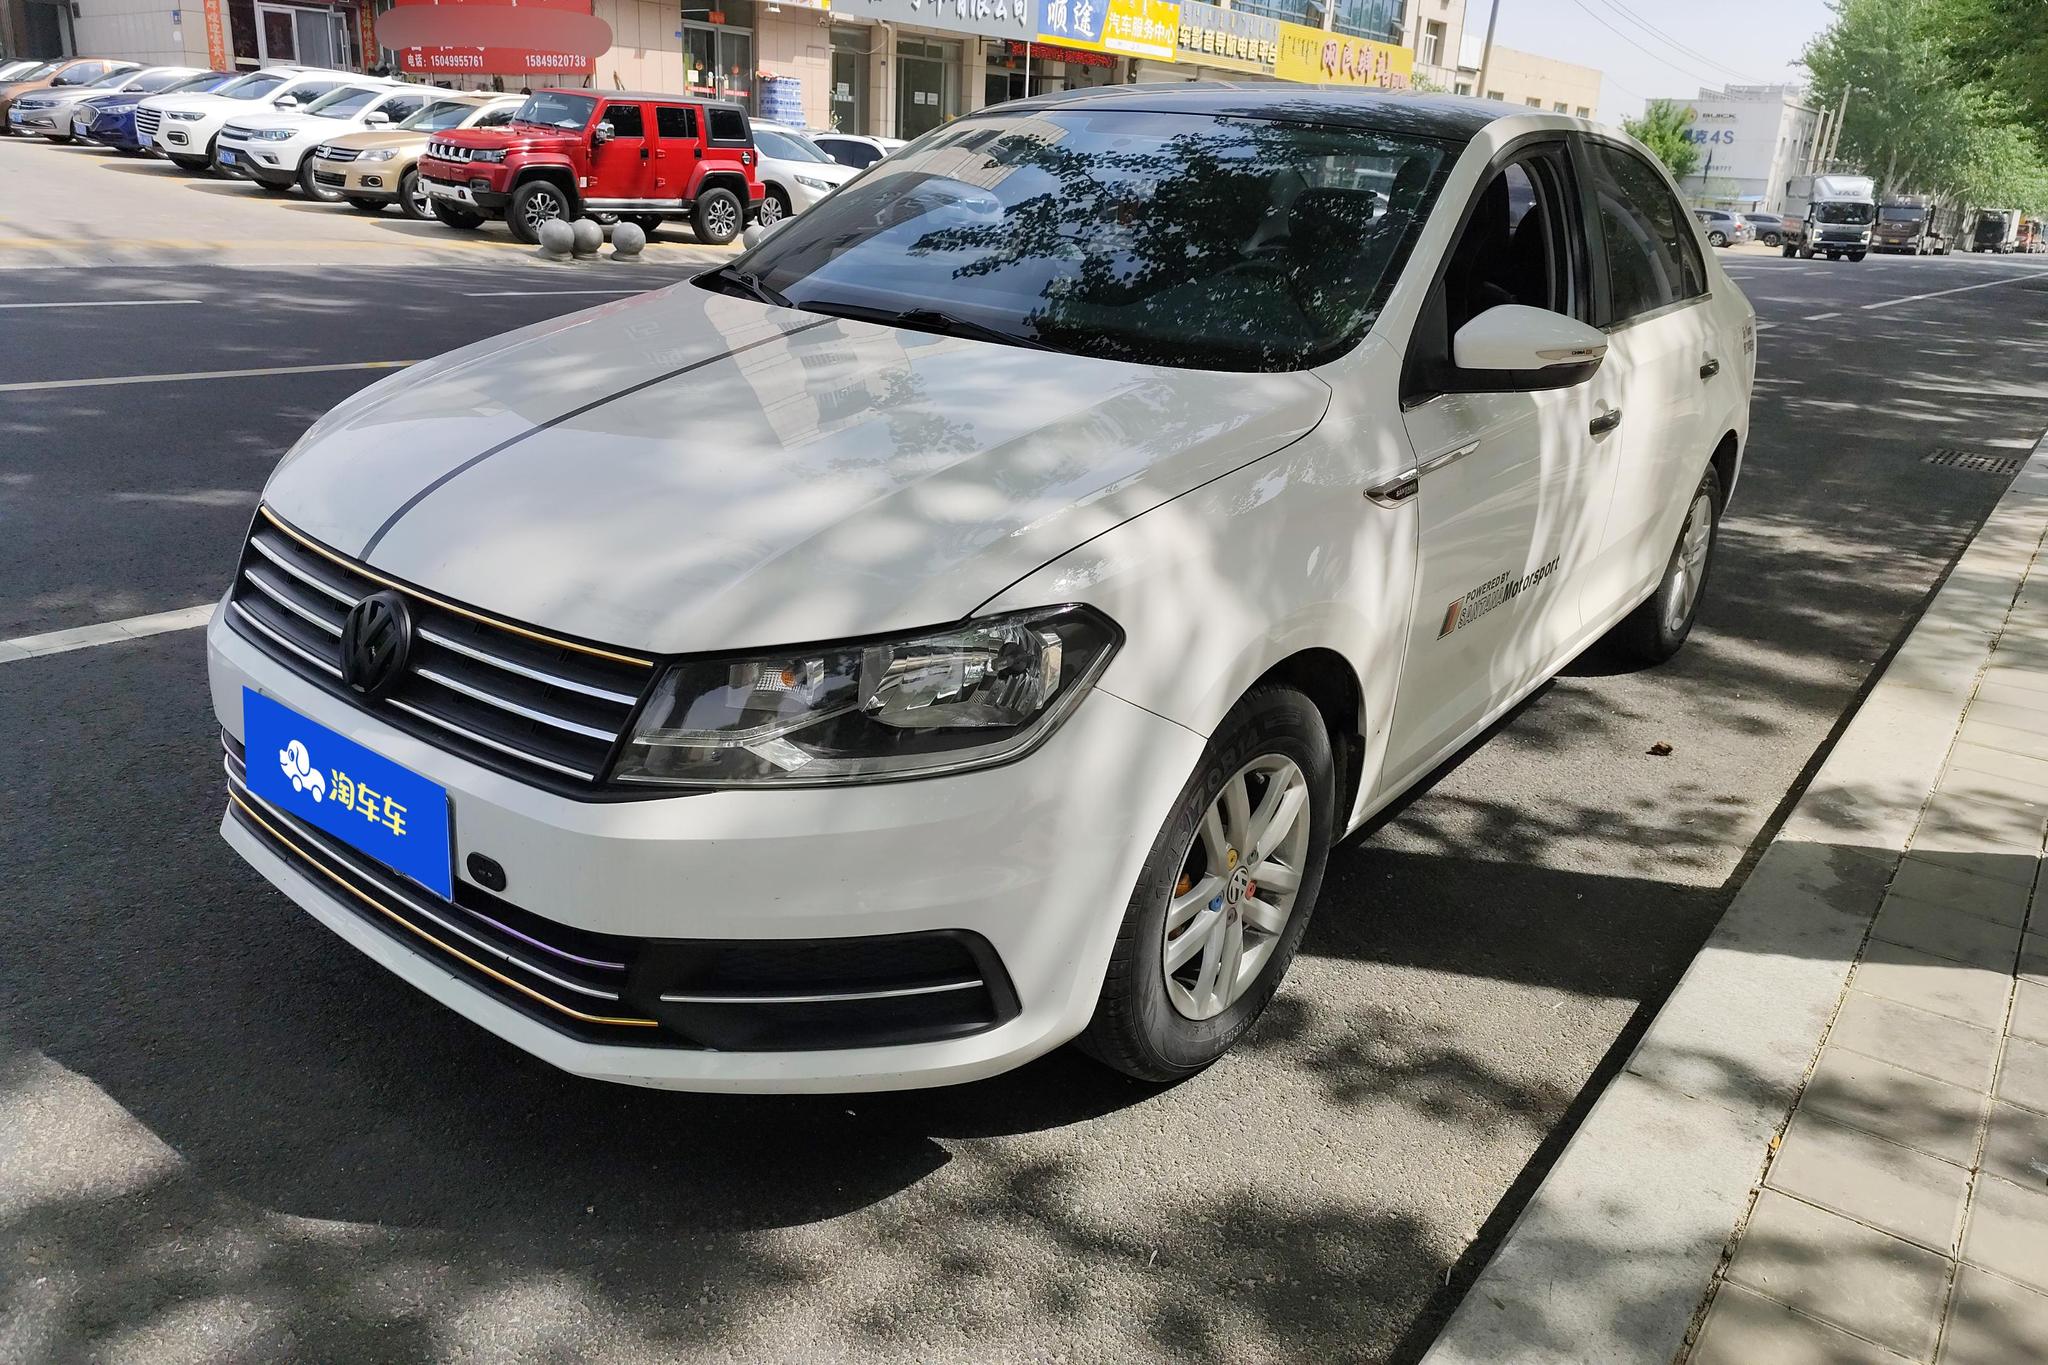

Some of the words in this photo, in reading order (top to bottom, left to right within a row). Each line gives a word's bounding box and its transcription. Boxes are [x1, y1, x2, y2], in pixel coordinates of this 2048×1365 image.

[1047, 0, 1095, 37] 顺途
[1108, 12, 1176, 44] 汽车服务中心
[430, 55, 484, 68] 15049955761
[525, 55, 587, 68] 15849620738
[1465, 576, 1501, 604] POWERED
[1500, 569, 1512, 585] BY
